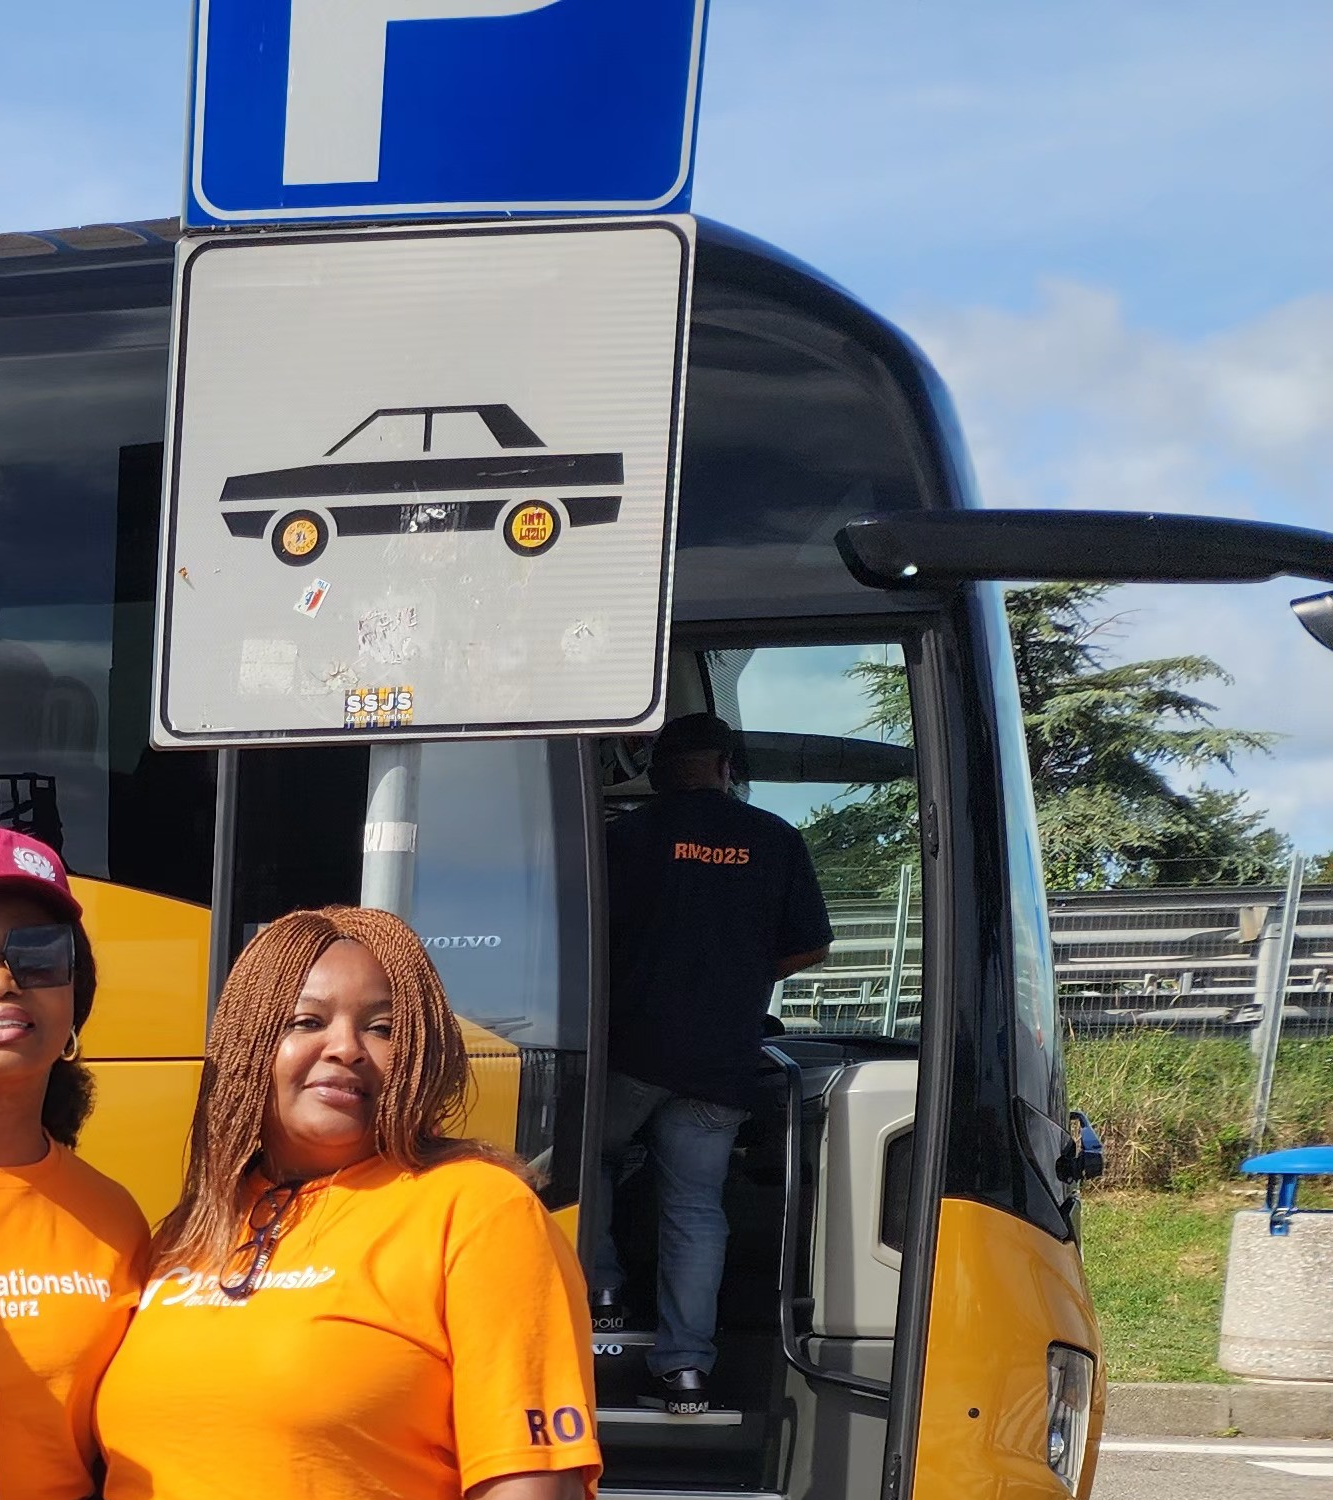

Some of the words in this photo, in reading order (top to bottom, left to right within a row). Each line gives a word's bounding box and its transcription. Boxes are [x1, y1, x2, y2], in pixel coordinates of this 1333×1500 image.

[521, 512, 546, 526] ANTI
[345, 691, 413, 714] SSJS
[674, 842, 750, 865] RM2025
[420, 935, 502, 949] VOLVO
